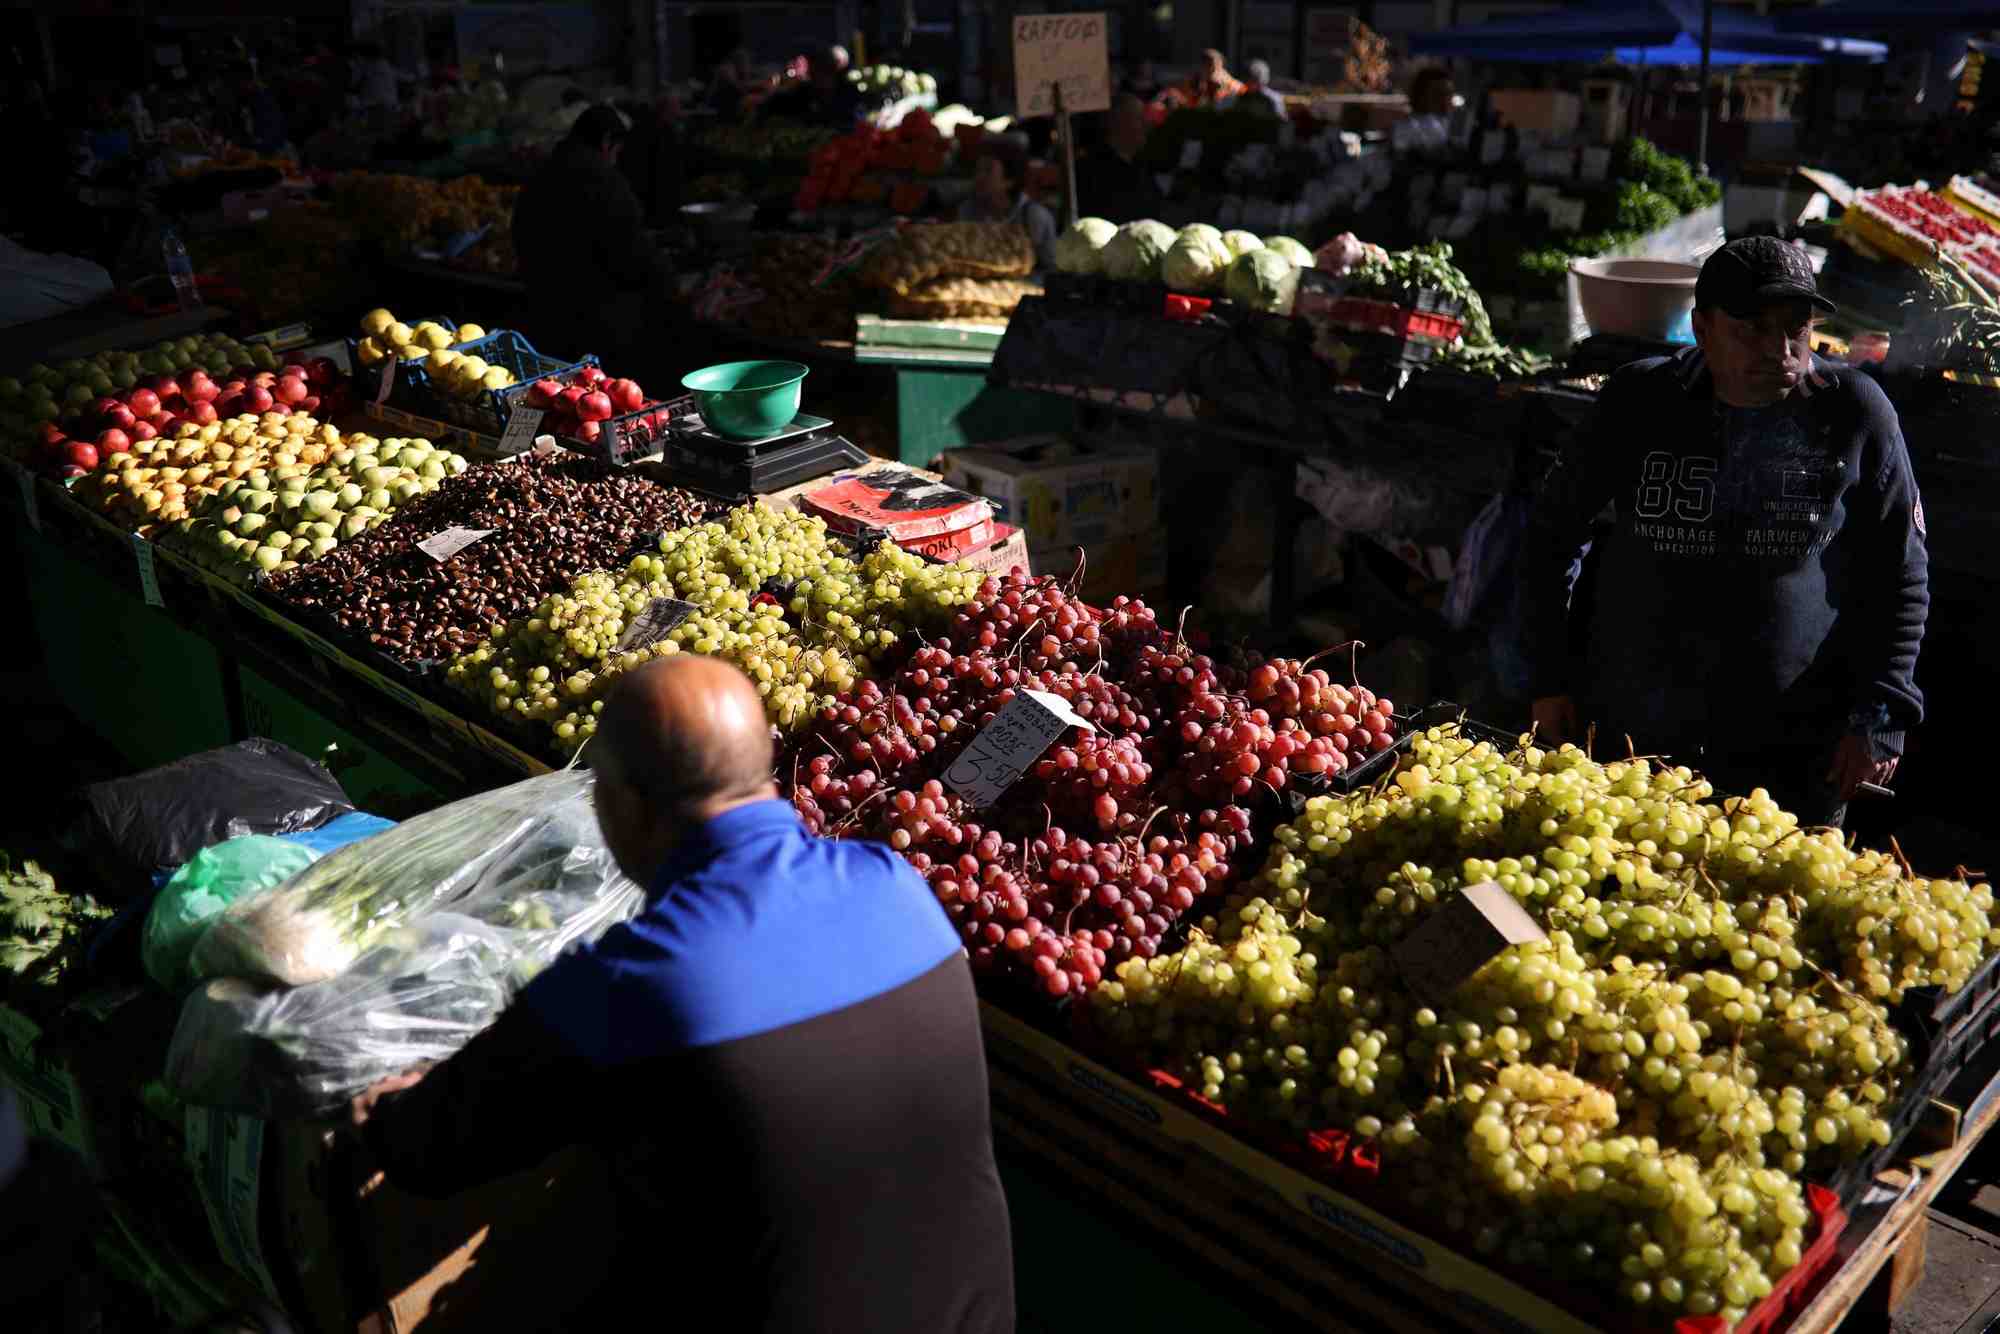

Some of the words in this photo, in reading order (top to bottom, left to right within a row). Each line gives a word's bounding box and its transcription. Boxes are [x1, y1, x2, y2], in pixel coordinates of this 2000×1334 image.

[1635, 450, 1719, 523] 85
[1633, 520, 1718, 542] ANCHORAGE
[1745, 528, 1810, 543] FAIRVIEW
[949, 745, 993, 785] 3
[985, 763, 1022, 789] 50
